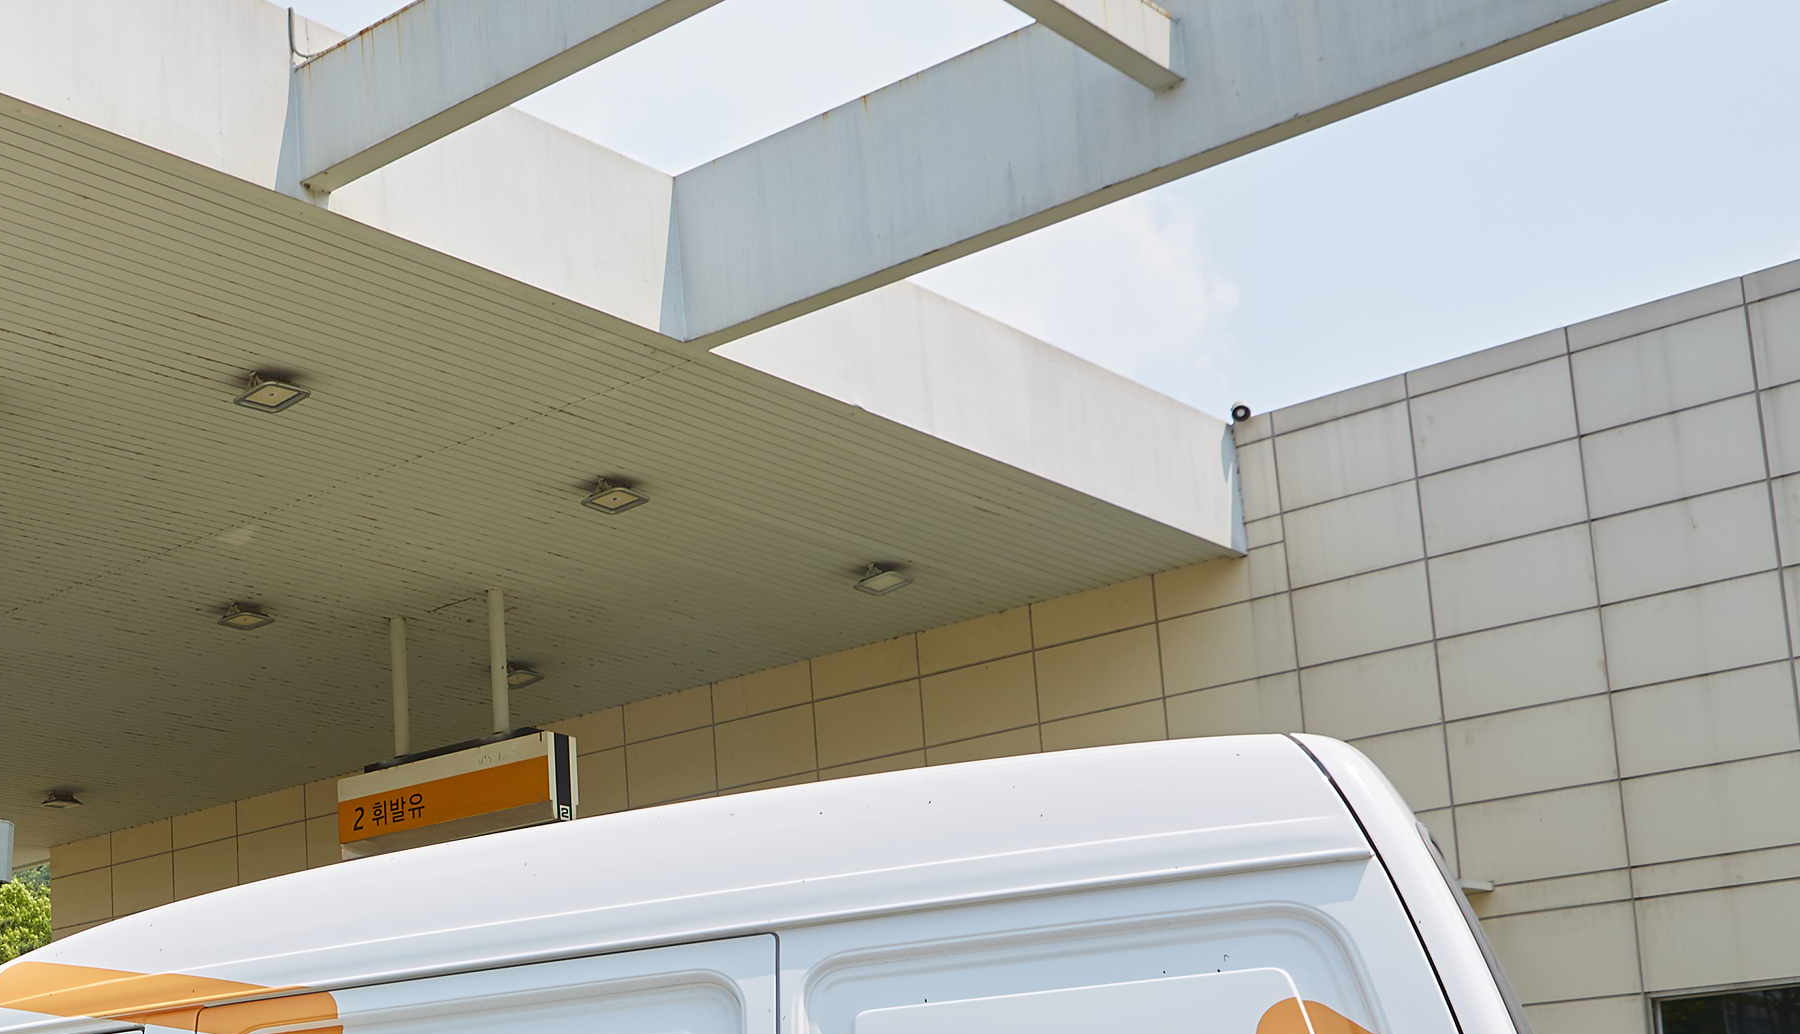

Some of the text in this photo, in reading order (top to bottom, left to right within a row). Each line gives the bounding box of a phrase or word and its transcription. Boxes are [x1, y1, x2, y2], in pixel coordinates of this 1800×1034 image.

[353, 793, 425, 831] 2 휘발유
[560, 807, 569, 818] 2
